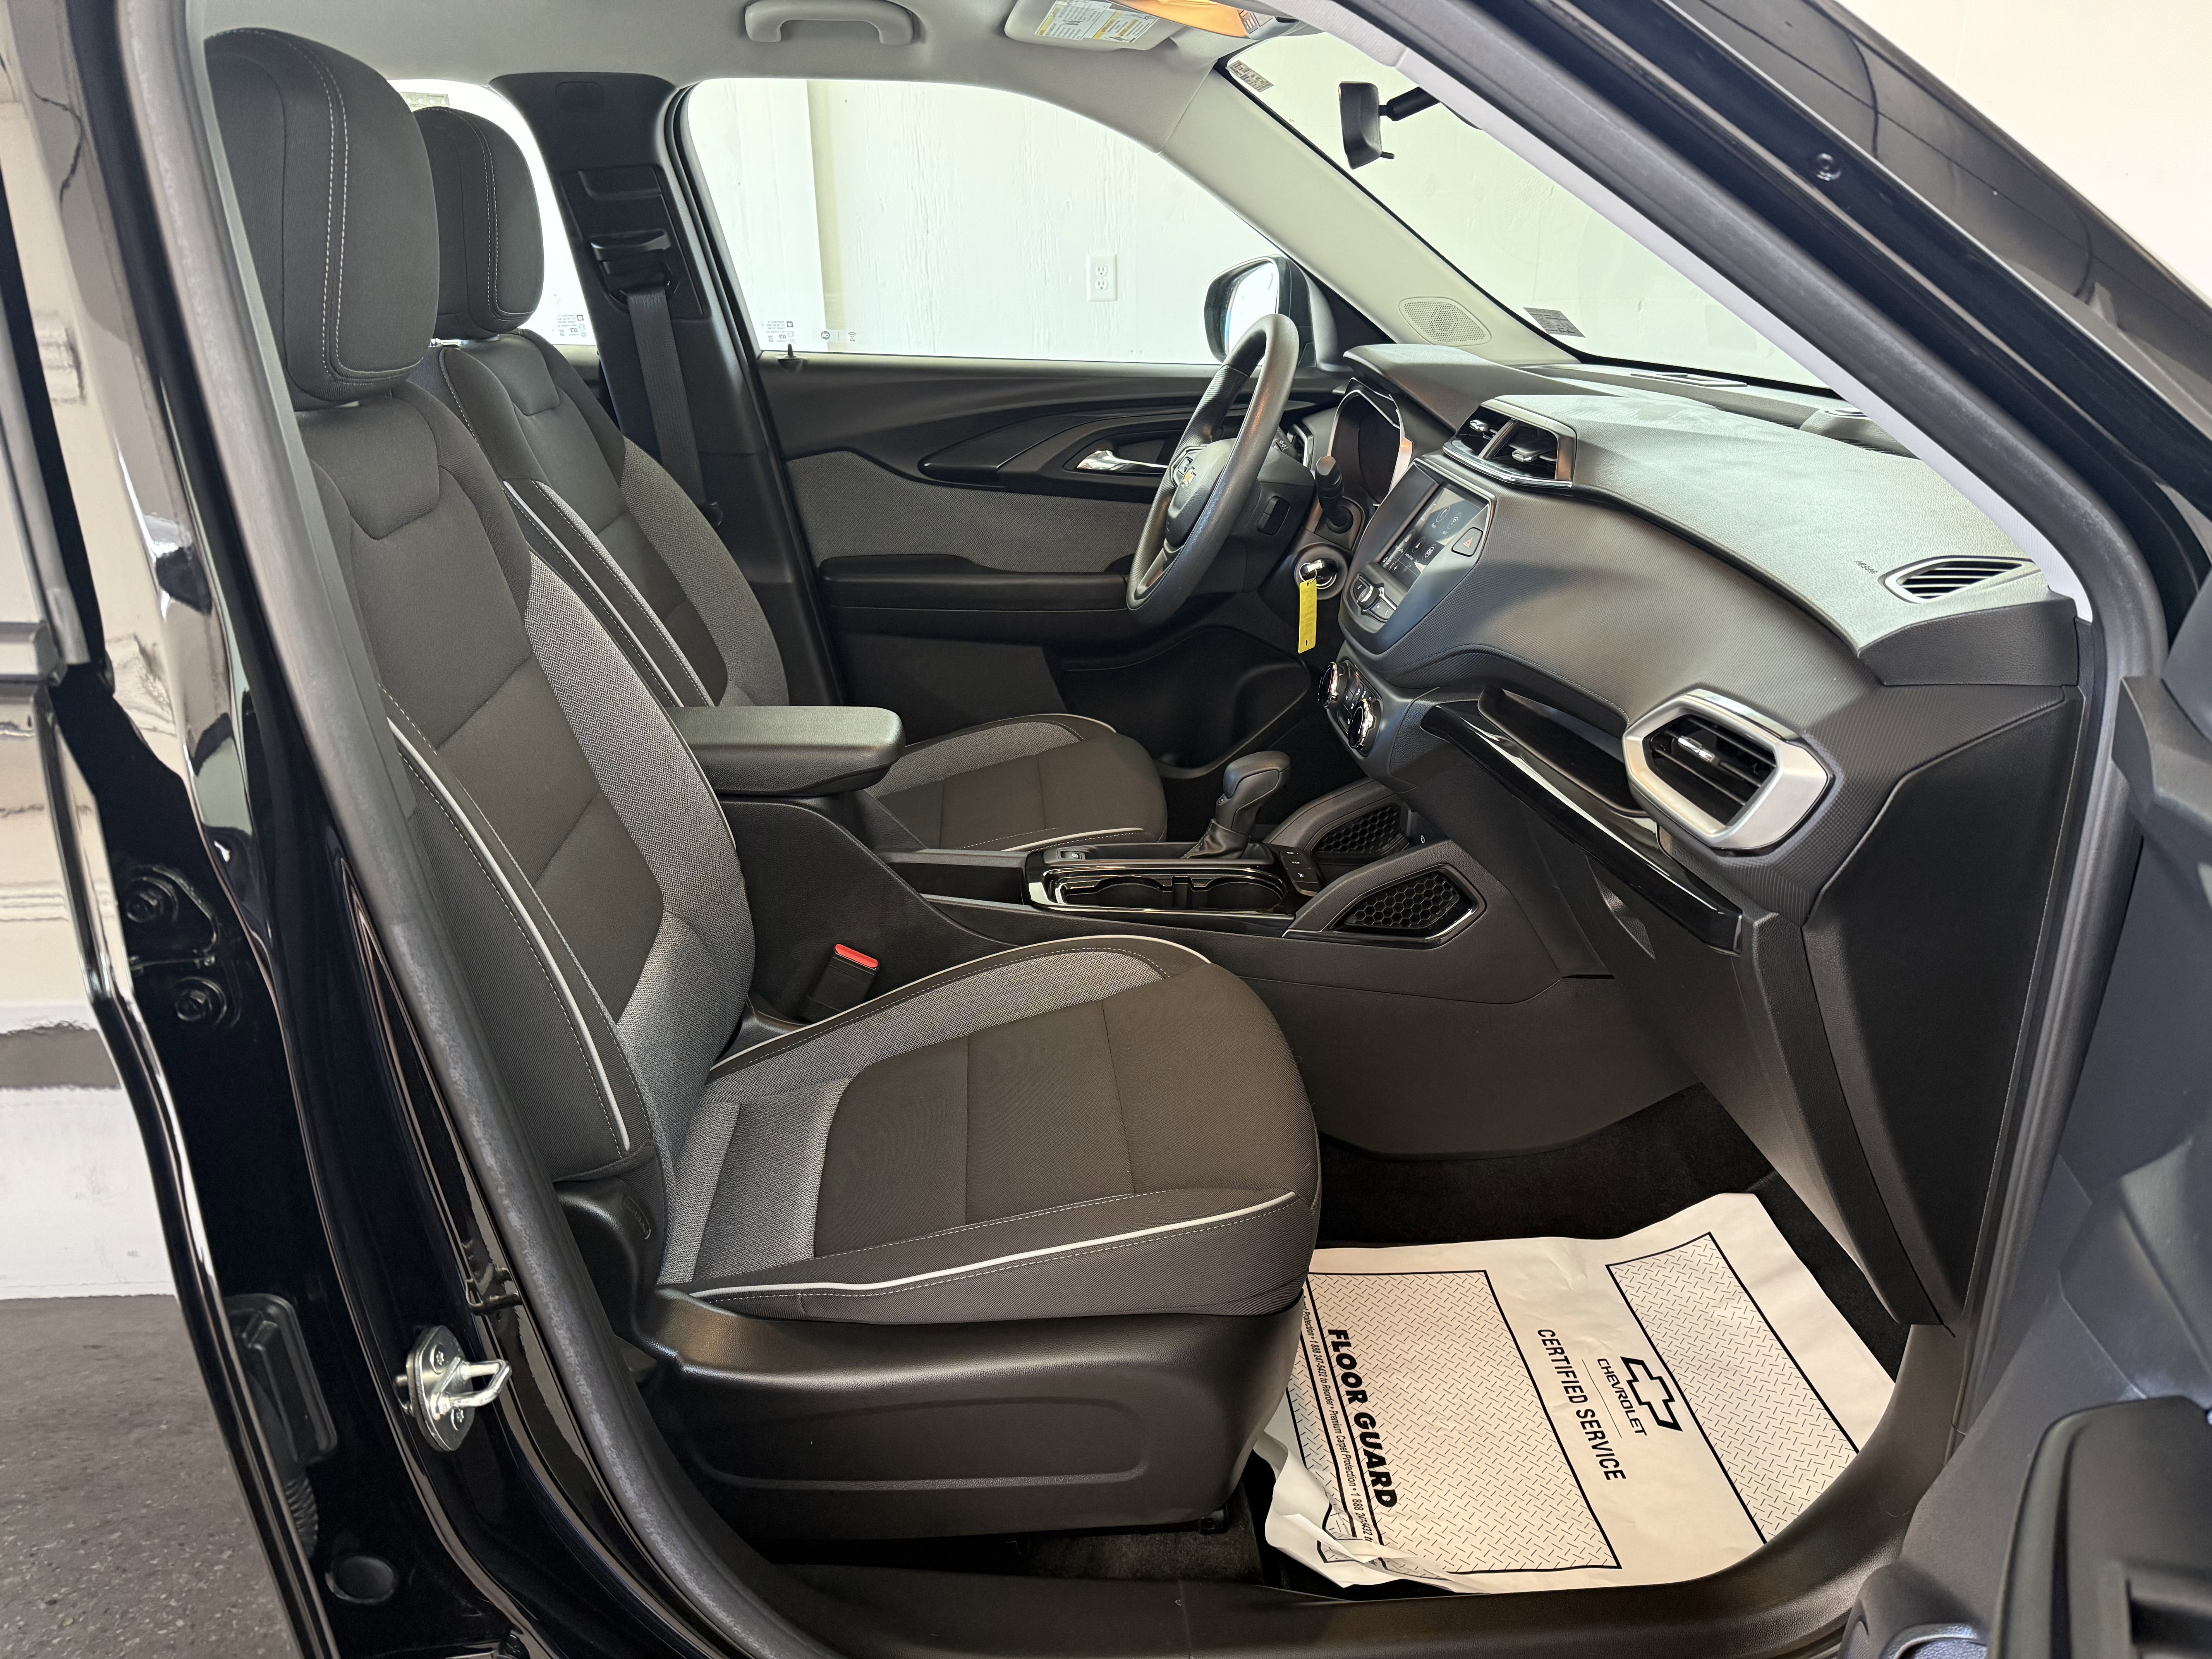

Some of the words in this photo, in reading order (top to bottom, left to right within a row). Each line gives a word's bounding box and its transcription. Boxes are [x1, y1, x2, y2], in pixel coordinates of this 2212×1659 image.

[1304, 1311, 1314, 1336] Protection
[1310, 1344, 1321, 1353] 888
[1312, 1354, 1326, 1377] 247-5432
[1322, 1384, 1334, 1405] Reorder
[1537, 1329, 1589, 1403] CERTIFIED
[1576, 1409, 1626, 1480] SERVICE
[1597, 1358, 1648, 1436] CHEVROLET
[1328, 1329, 1368, 1404] FLOOR
[1354, 1412, 1397, 1508] GUARD
[1329, 1410, 1342, 1434] Premium
[1336, 1435, 1347, 1453] Carpet
[1341, 1454, 1357, 1486] Protection
[1352, 1499, 1364, 1511] 888
